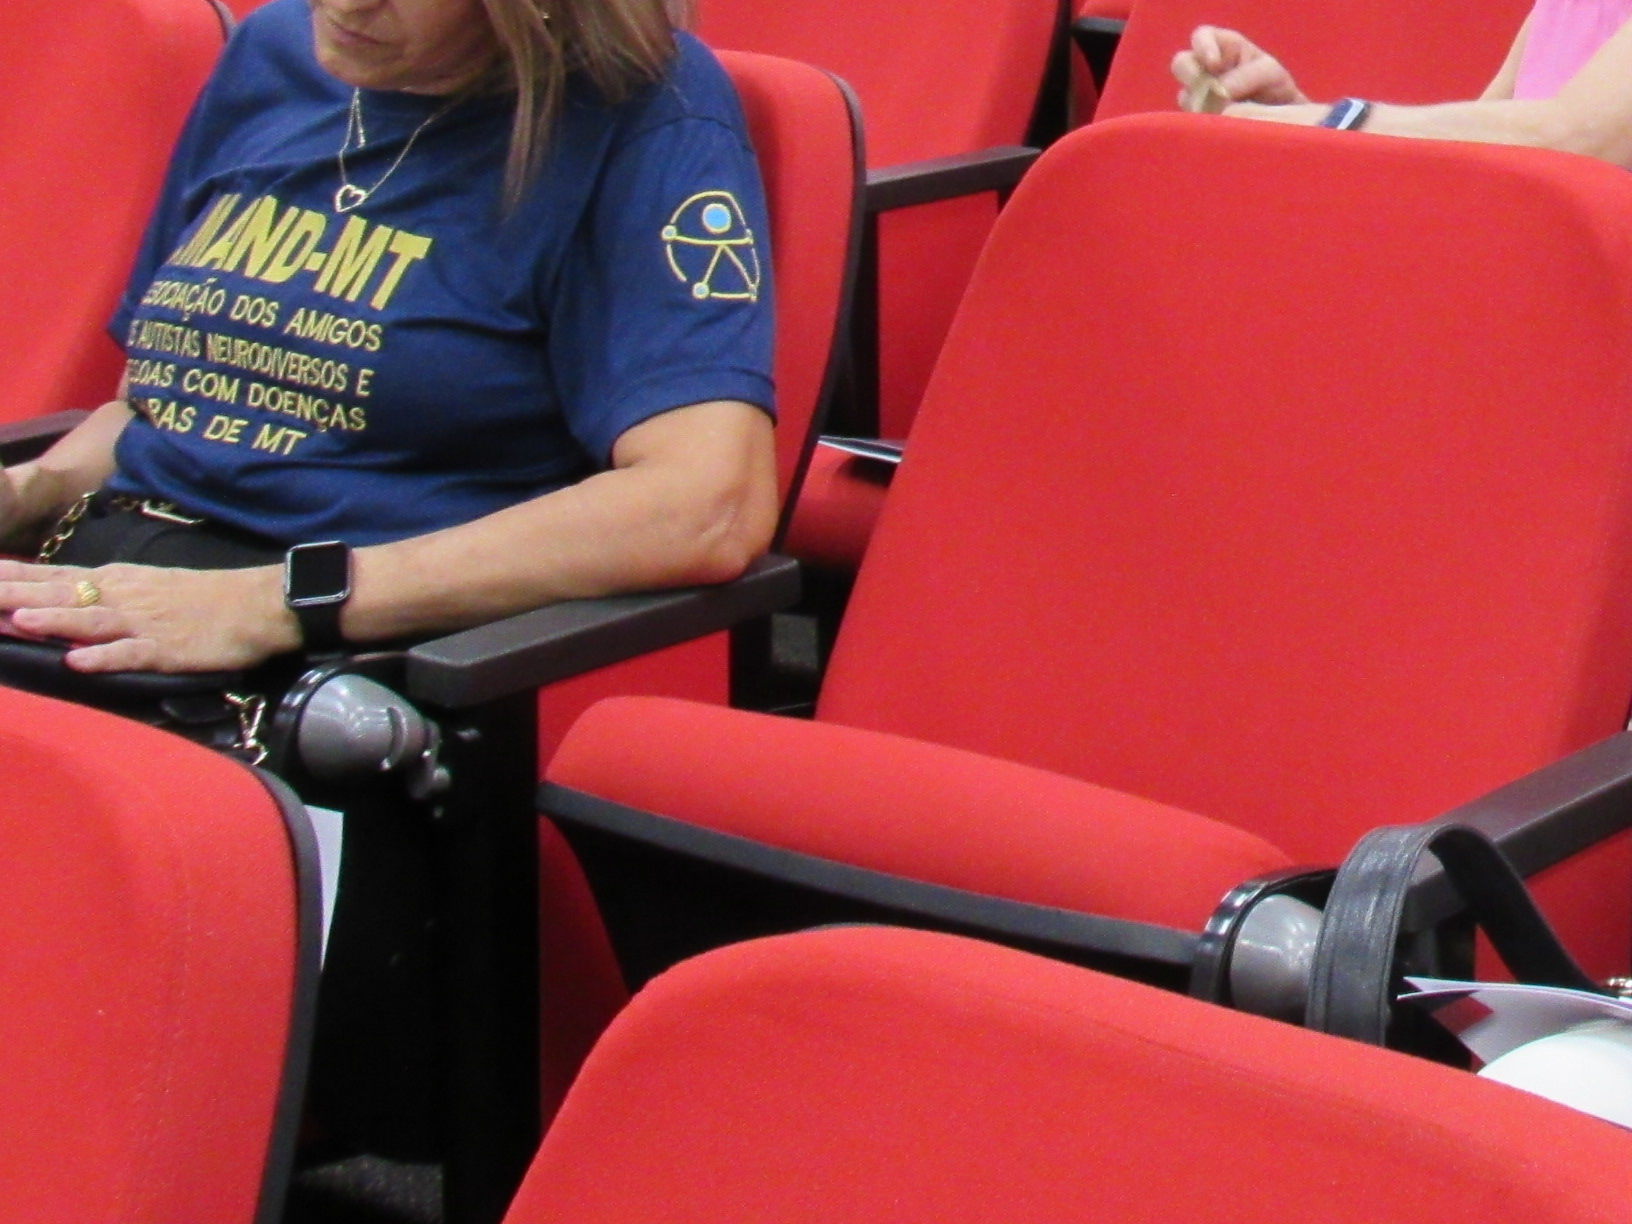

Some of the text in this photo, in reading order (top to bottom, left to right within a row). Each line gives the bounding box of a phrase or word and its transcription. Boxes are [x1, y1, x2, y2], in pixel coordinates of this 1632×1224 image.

[167, 193, 433, 310] MAND-MT
[229, 295, 279, 328] DOS
[283, 307, 382, 352] AMIGOS
[136, 321, 200, 358] AUTISTAS
[206, 332, 349, 393] NEURODIVERSOS
[355, 368, 375, 398] E
[182, 368, 241, 404] COM
[247, 382, 367, 433] DOENÇAS
[203, 415, 249, 443] DE
[252, 424, 308, 456] MT
